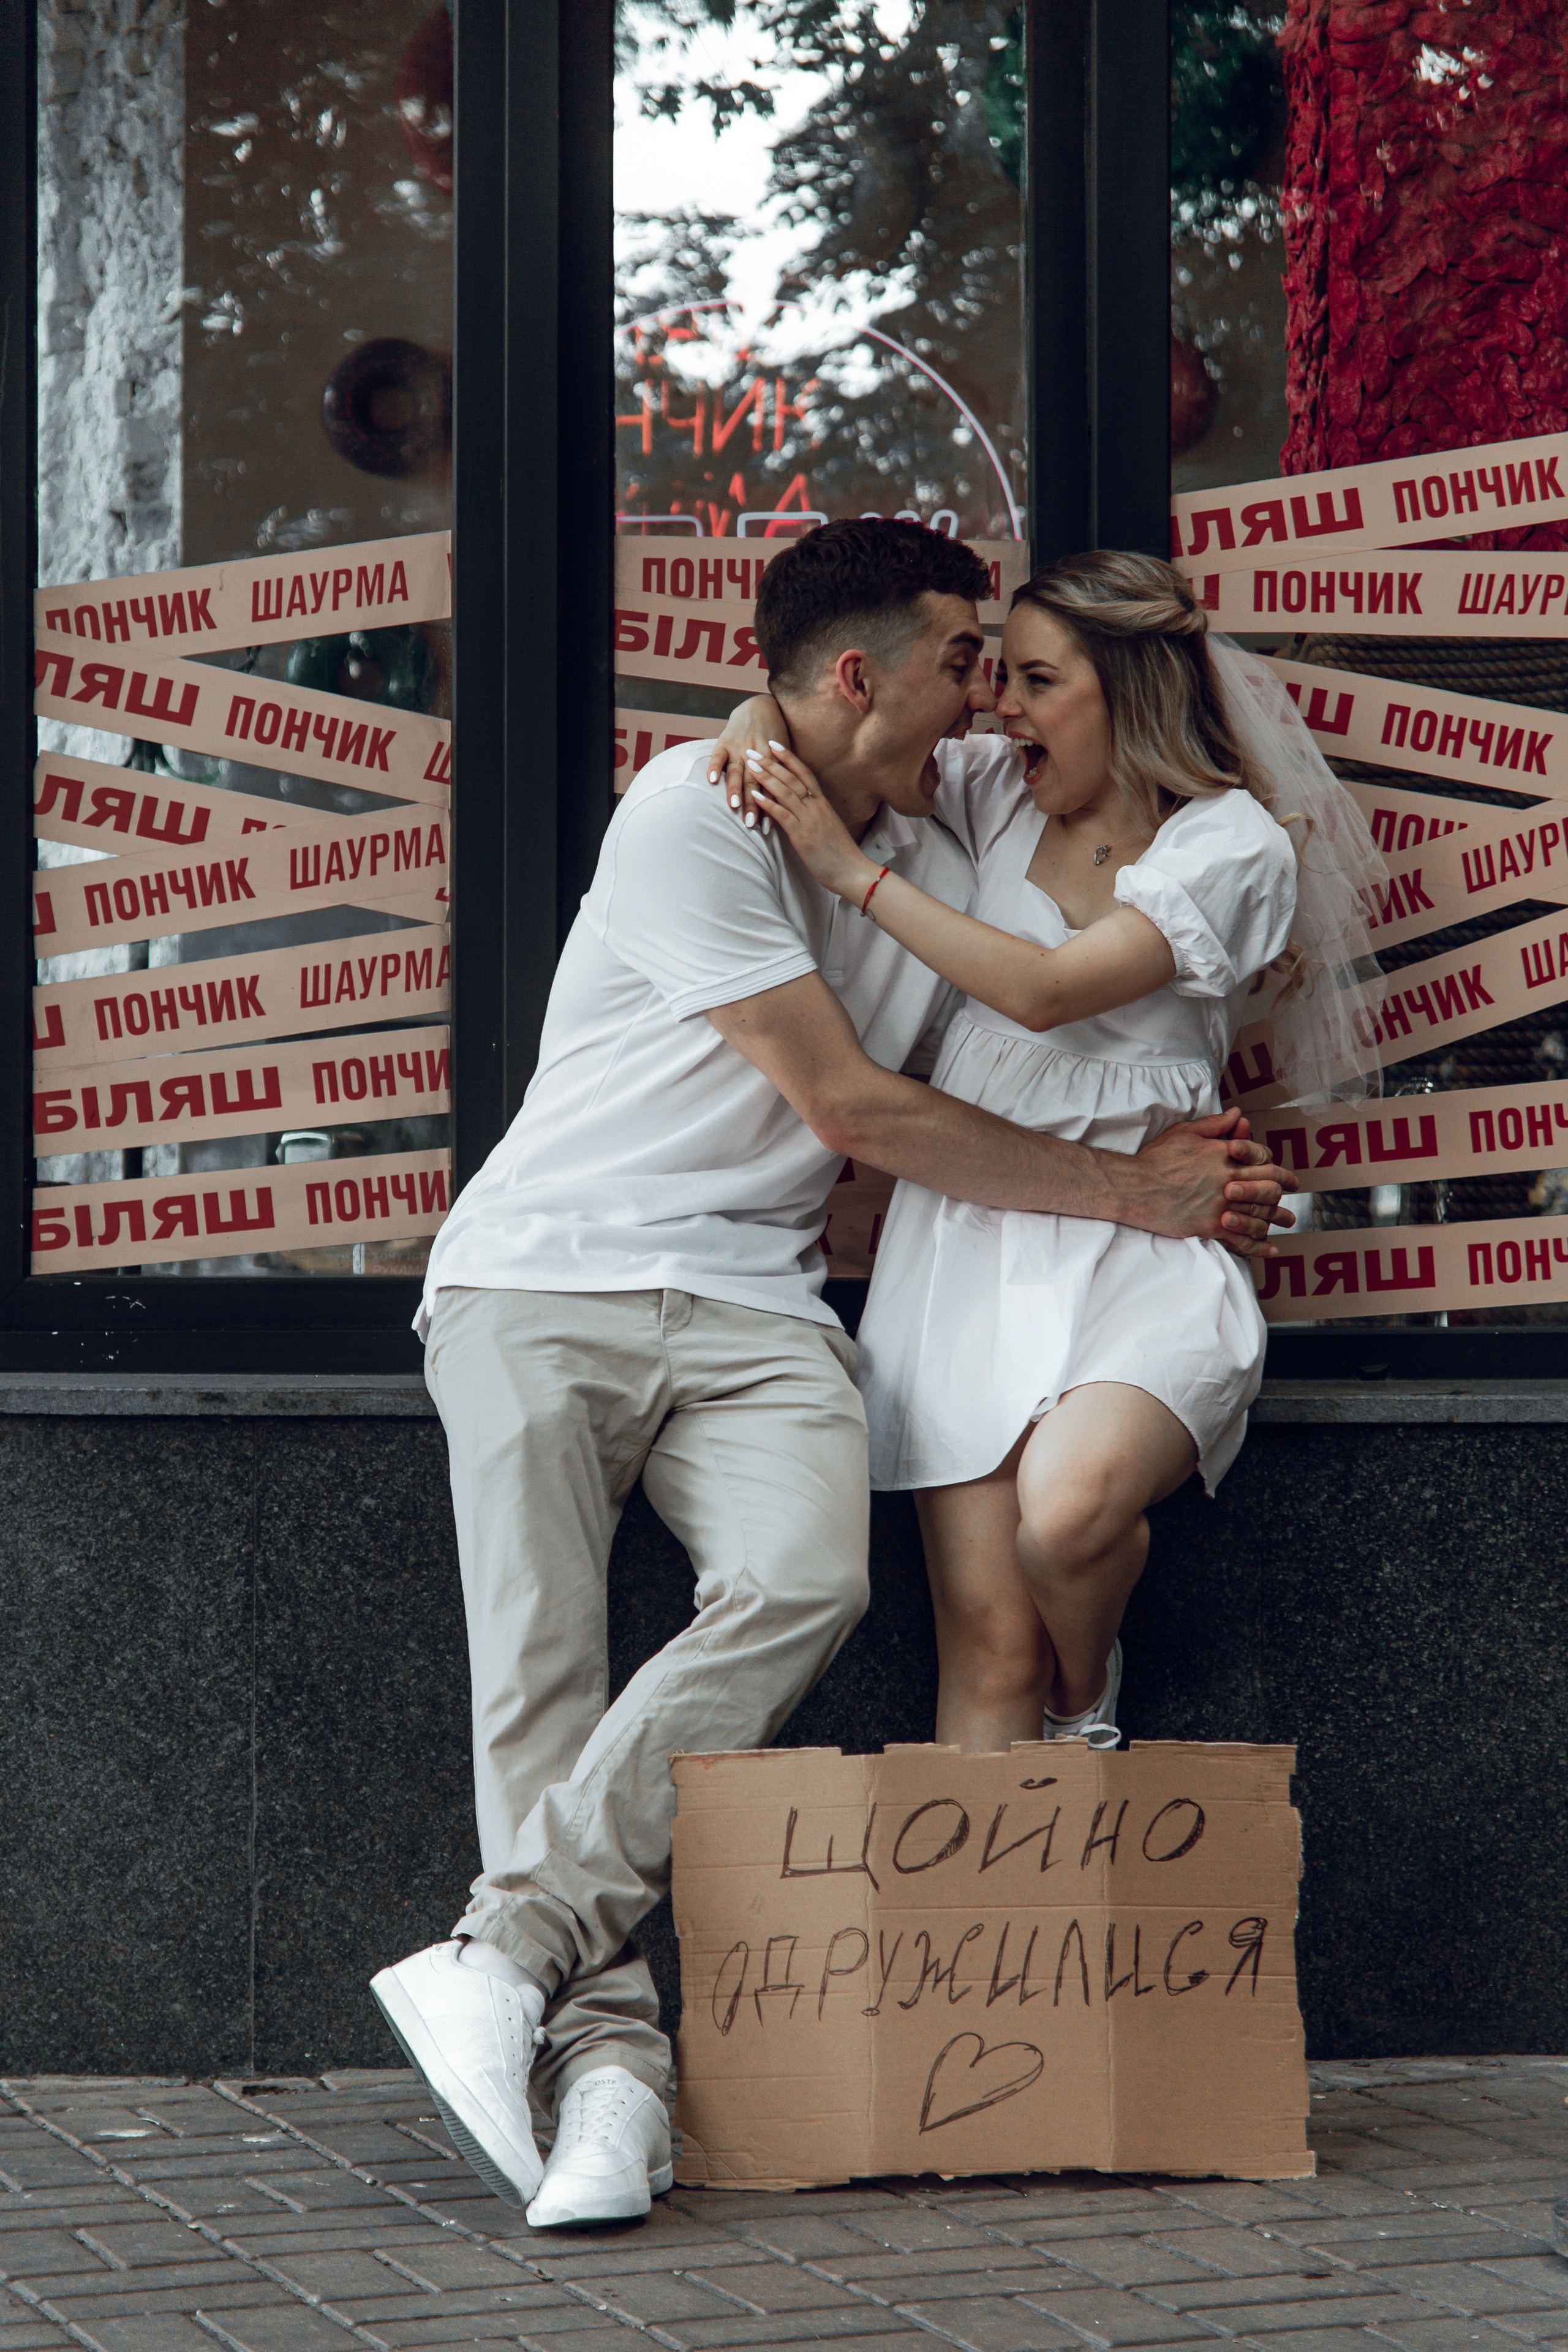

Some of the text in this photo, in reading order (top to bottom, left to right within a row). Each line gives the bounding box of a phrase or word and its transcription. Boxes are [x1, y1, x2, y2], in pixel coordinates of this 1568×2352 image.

[1392, 456, 1566, 524] ПОНЧИК
[251, 560, 409, 622] ШАУРМА
[1253, 570, 1423, 614] ПОНЧИК
[1457, 573, 1568, 615] ШАУР
[224, 695, 396, 772] ПОНЧИК
[1381, 703, 1553, 775] ПОНЧИК
[83, 858, 256, 927] ПОНЧИК
[290, 823, 446, 890] ШАУРМА
[94, 974, 266, 1041] ПОНЧИК
[33, 1066, 282, 1134] БІЛЯШ
[31, 1169, 451, 1252] БІЛЯШ ПОНЧИ
[780, 1777, 1205, 1893] ЩОЙНО
[712, 1917, 1268, 2036] ОДРУЖИЛИСЯ
